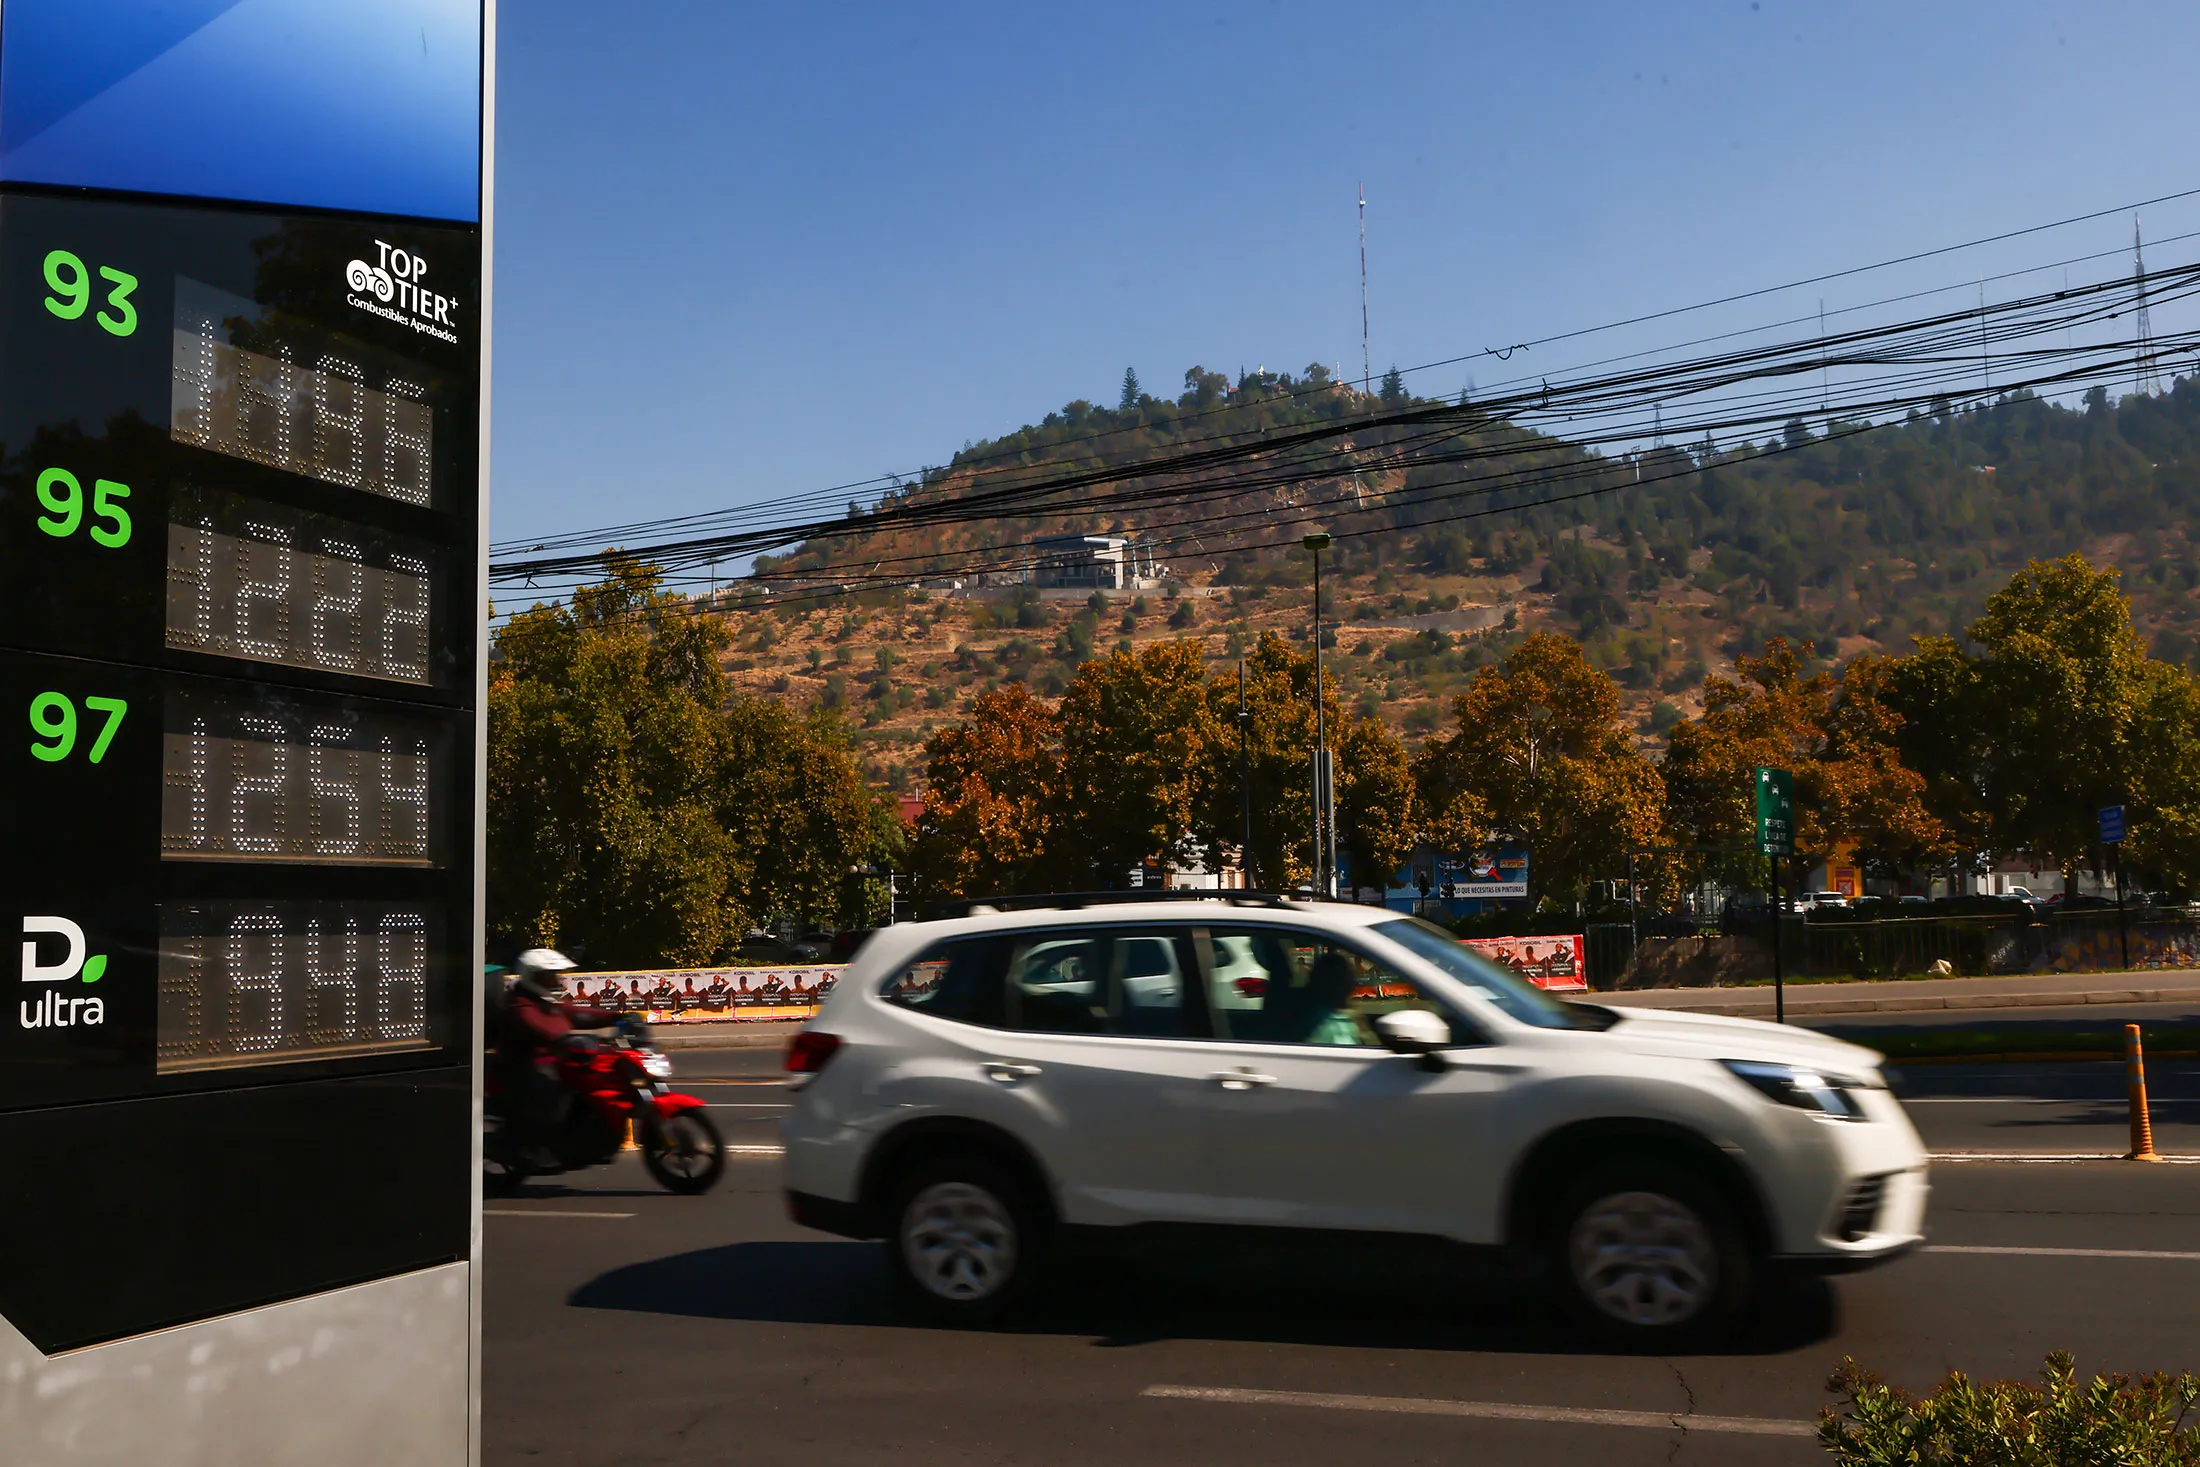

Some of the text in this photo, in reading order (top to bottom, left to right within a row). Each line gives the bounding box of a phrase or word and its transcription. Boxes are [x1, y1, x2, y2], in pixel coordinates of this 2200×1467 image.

[42, 249, 139, 337] 93
[374, 239, 428, 284] TOP
[346, 293, 458, 344] Combustibles Aprobados
[36, 467, 132, 548] 95
[198, 517, 429, 680] 1222
[29, 691, 128, 764] 97
[192, 716, 428, 855] 1254
[1471, 886, 1495, 894] NECESITAS
[1501, 885, 1524, 893] PINTURAS
[20, 989, 104, 1029] ultra
